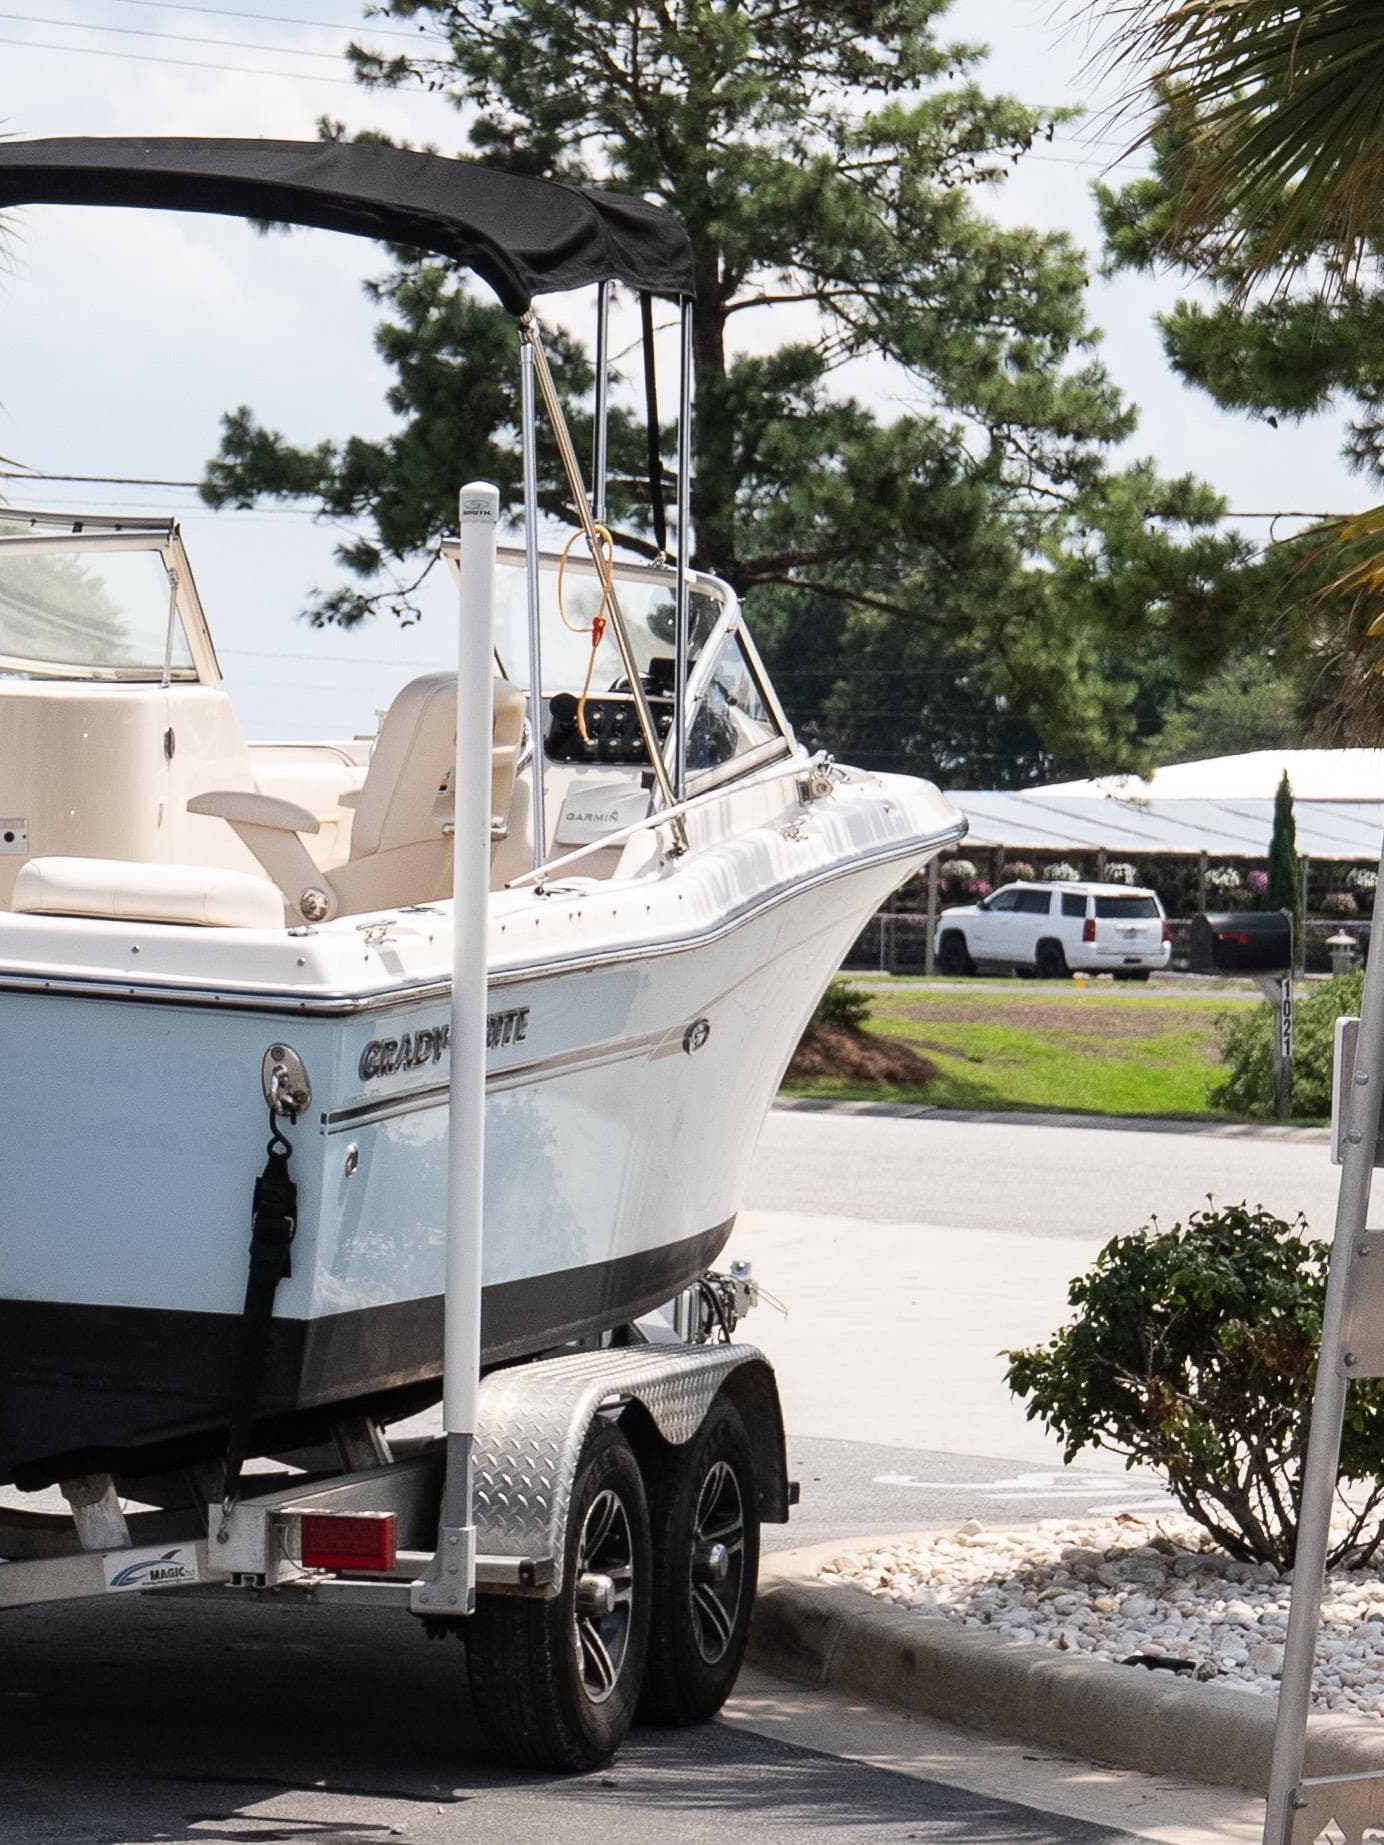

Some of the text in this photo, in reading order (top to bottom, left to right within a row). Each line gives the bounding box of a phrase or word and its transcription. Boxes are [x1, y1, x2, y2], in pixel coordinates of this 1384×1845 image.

[566, 812, 618, 822] GARMIN
[1282, 979, 1292, 1058] 1021
[150, 1567, 185, 1581] MAGIC
